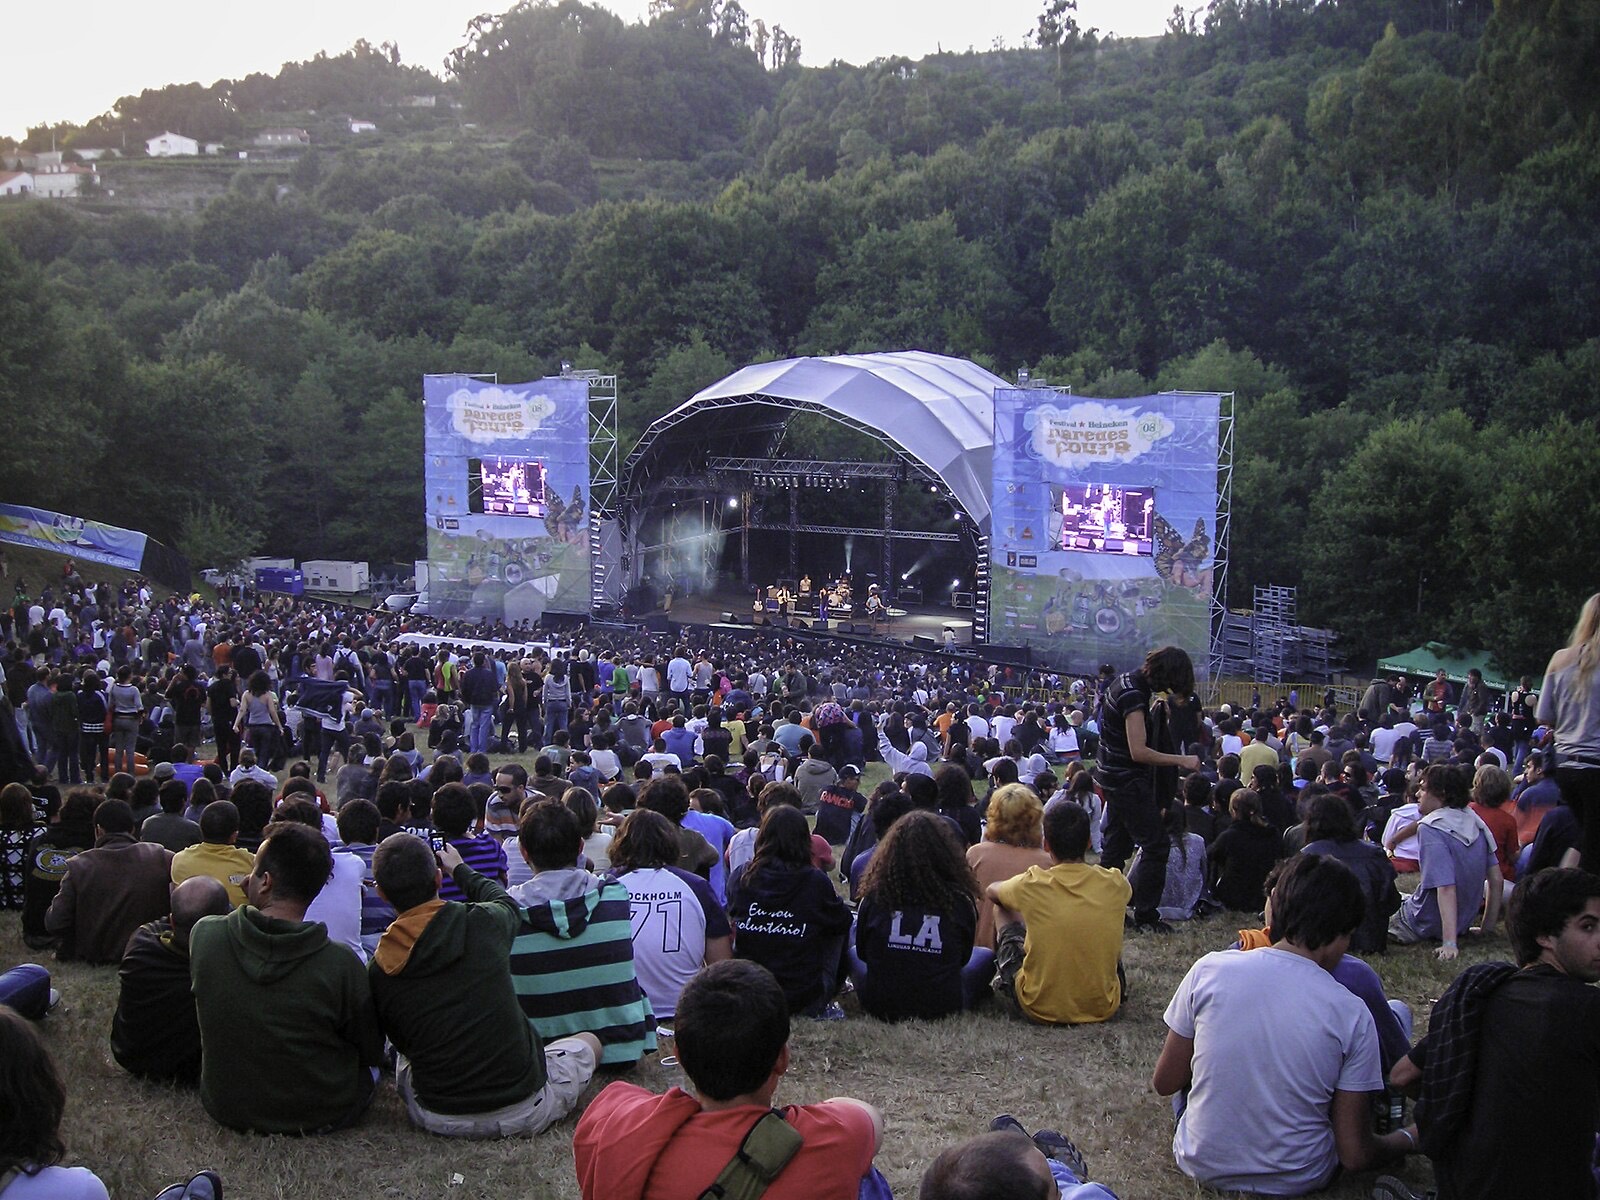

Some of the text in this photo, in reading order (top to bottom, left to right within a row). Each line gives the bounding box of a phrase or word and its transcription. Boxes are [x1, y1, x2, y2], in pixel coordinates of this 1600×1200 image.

[1049, 419, 1128, 429] Festival Heineken
[1142, 423, 1156, 433] 08
[748, 902, 794, 918] Eu sou
[630, 900, 681, 953] 71
[889, 910, 942, 949] LA
